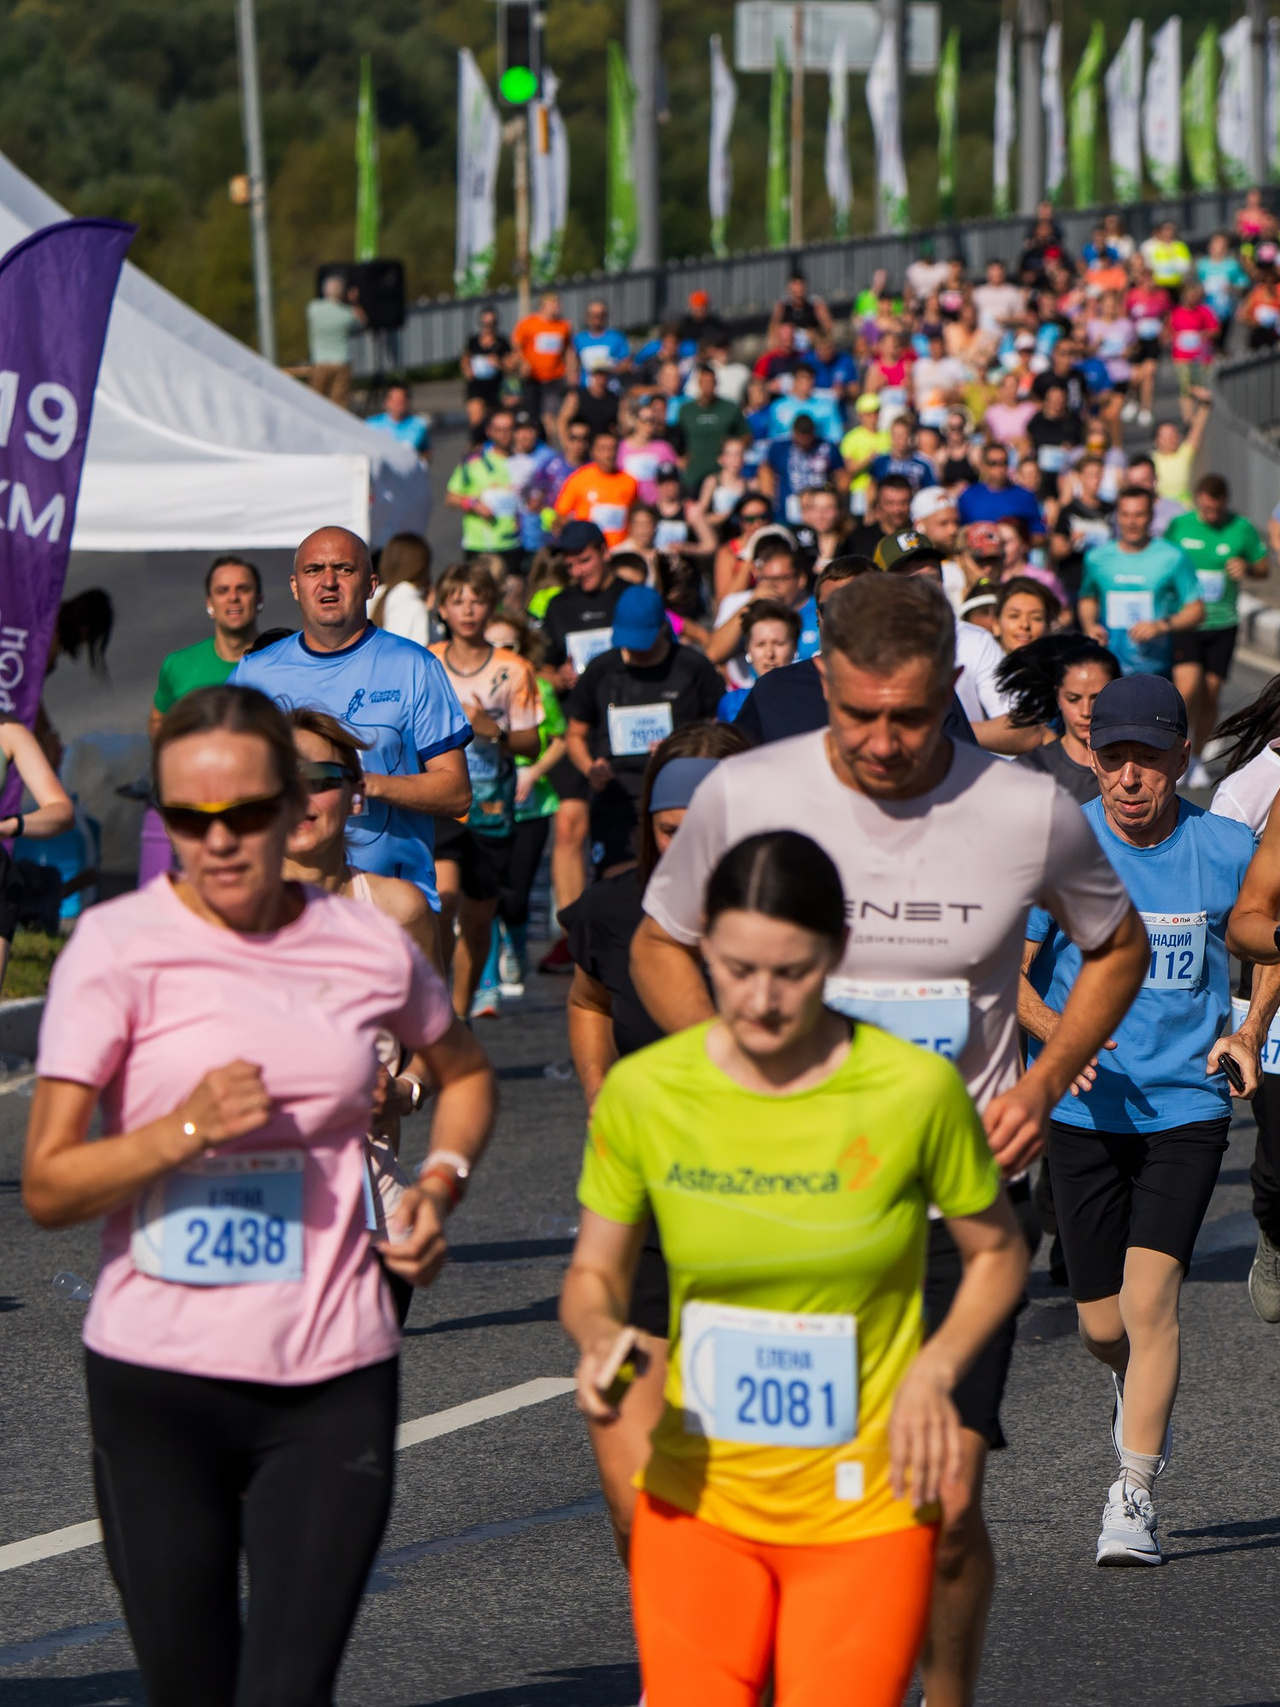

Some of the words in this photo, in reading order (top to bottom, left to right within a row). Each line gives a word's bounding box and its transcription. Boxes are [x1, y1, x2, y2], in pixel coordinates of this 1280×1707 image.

[0, 370, 78, 461] 19
[0, 479, 65, 543] М
[845, 901, 982, 924] NET
[1150, 950, 1194, 979] 112
[665, 1161, 840, 1196] AstraZeneca
[185, 1215, 286, 1266] 2438
[756, 1346, 812, 1371] ЕЛЕНА
[737, 1375, 835, 1429] 2081
